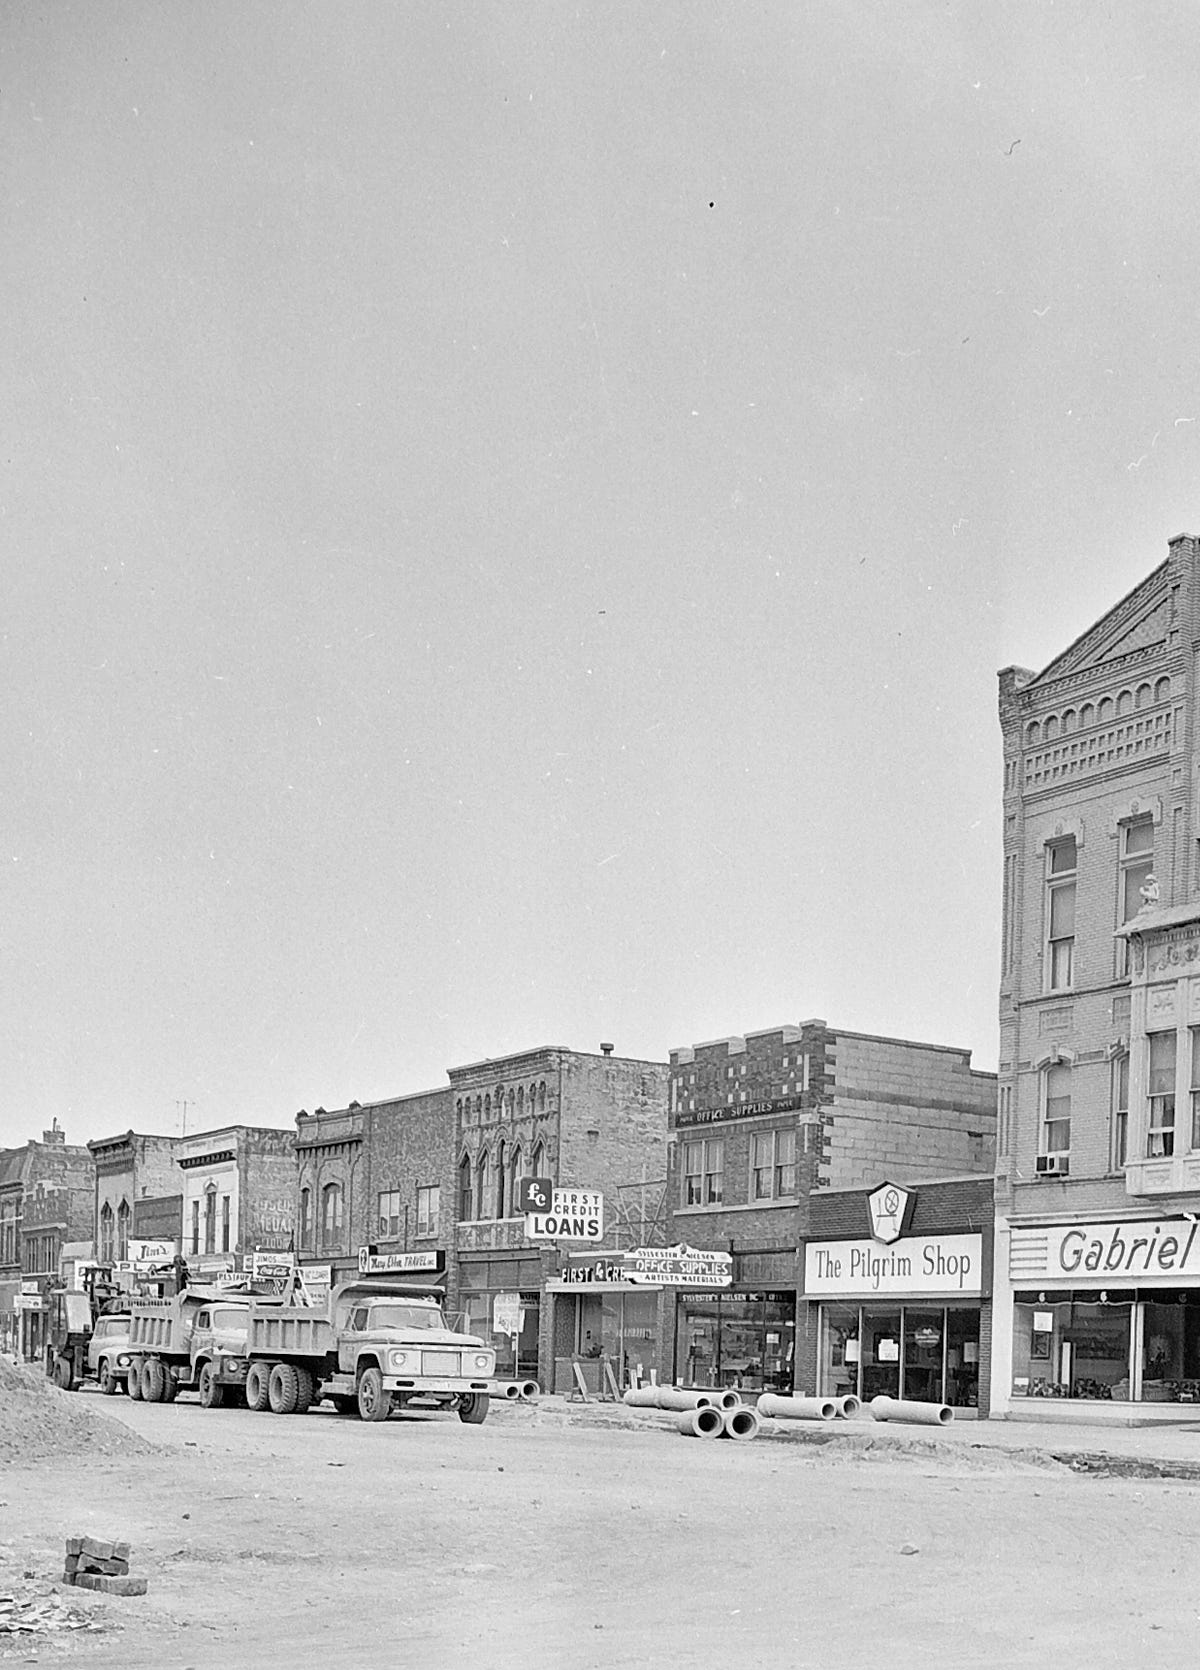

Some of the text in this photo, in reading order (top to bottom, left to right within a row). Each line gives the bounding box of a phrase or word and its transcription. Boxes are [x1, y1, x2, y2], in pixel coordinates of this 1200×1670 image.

[697, 1108, 725, 1122] OFFICE
[731, 1101, 773, 1117] SUPPLIES
[554, 1193, 599, 1205] FIRST
[554, 1205, 599, 1216] CREDIT
[534, 1217, 599, 1237] LOANS
[1059, 1222, 1198, 1274] Gabriel
[404, 1254, 427, 1267] TRAVEL
[636, 1260, 729, 1275] OFFICE SUPPLIES
[816, 1245, 971, 1290] The Pilgrim Shop
[561, 1267, 590, 1283] FIRST
[606, 1266, 625, 1282] CRE
[682, 1275, 724, 1284] MATERIALS
